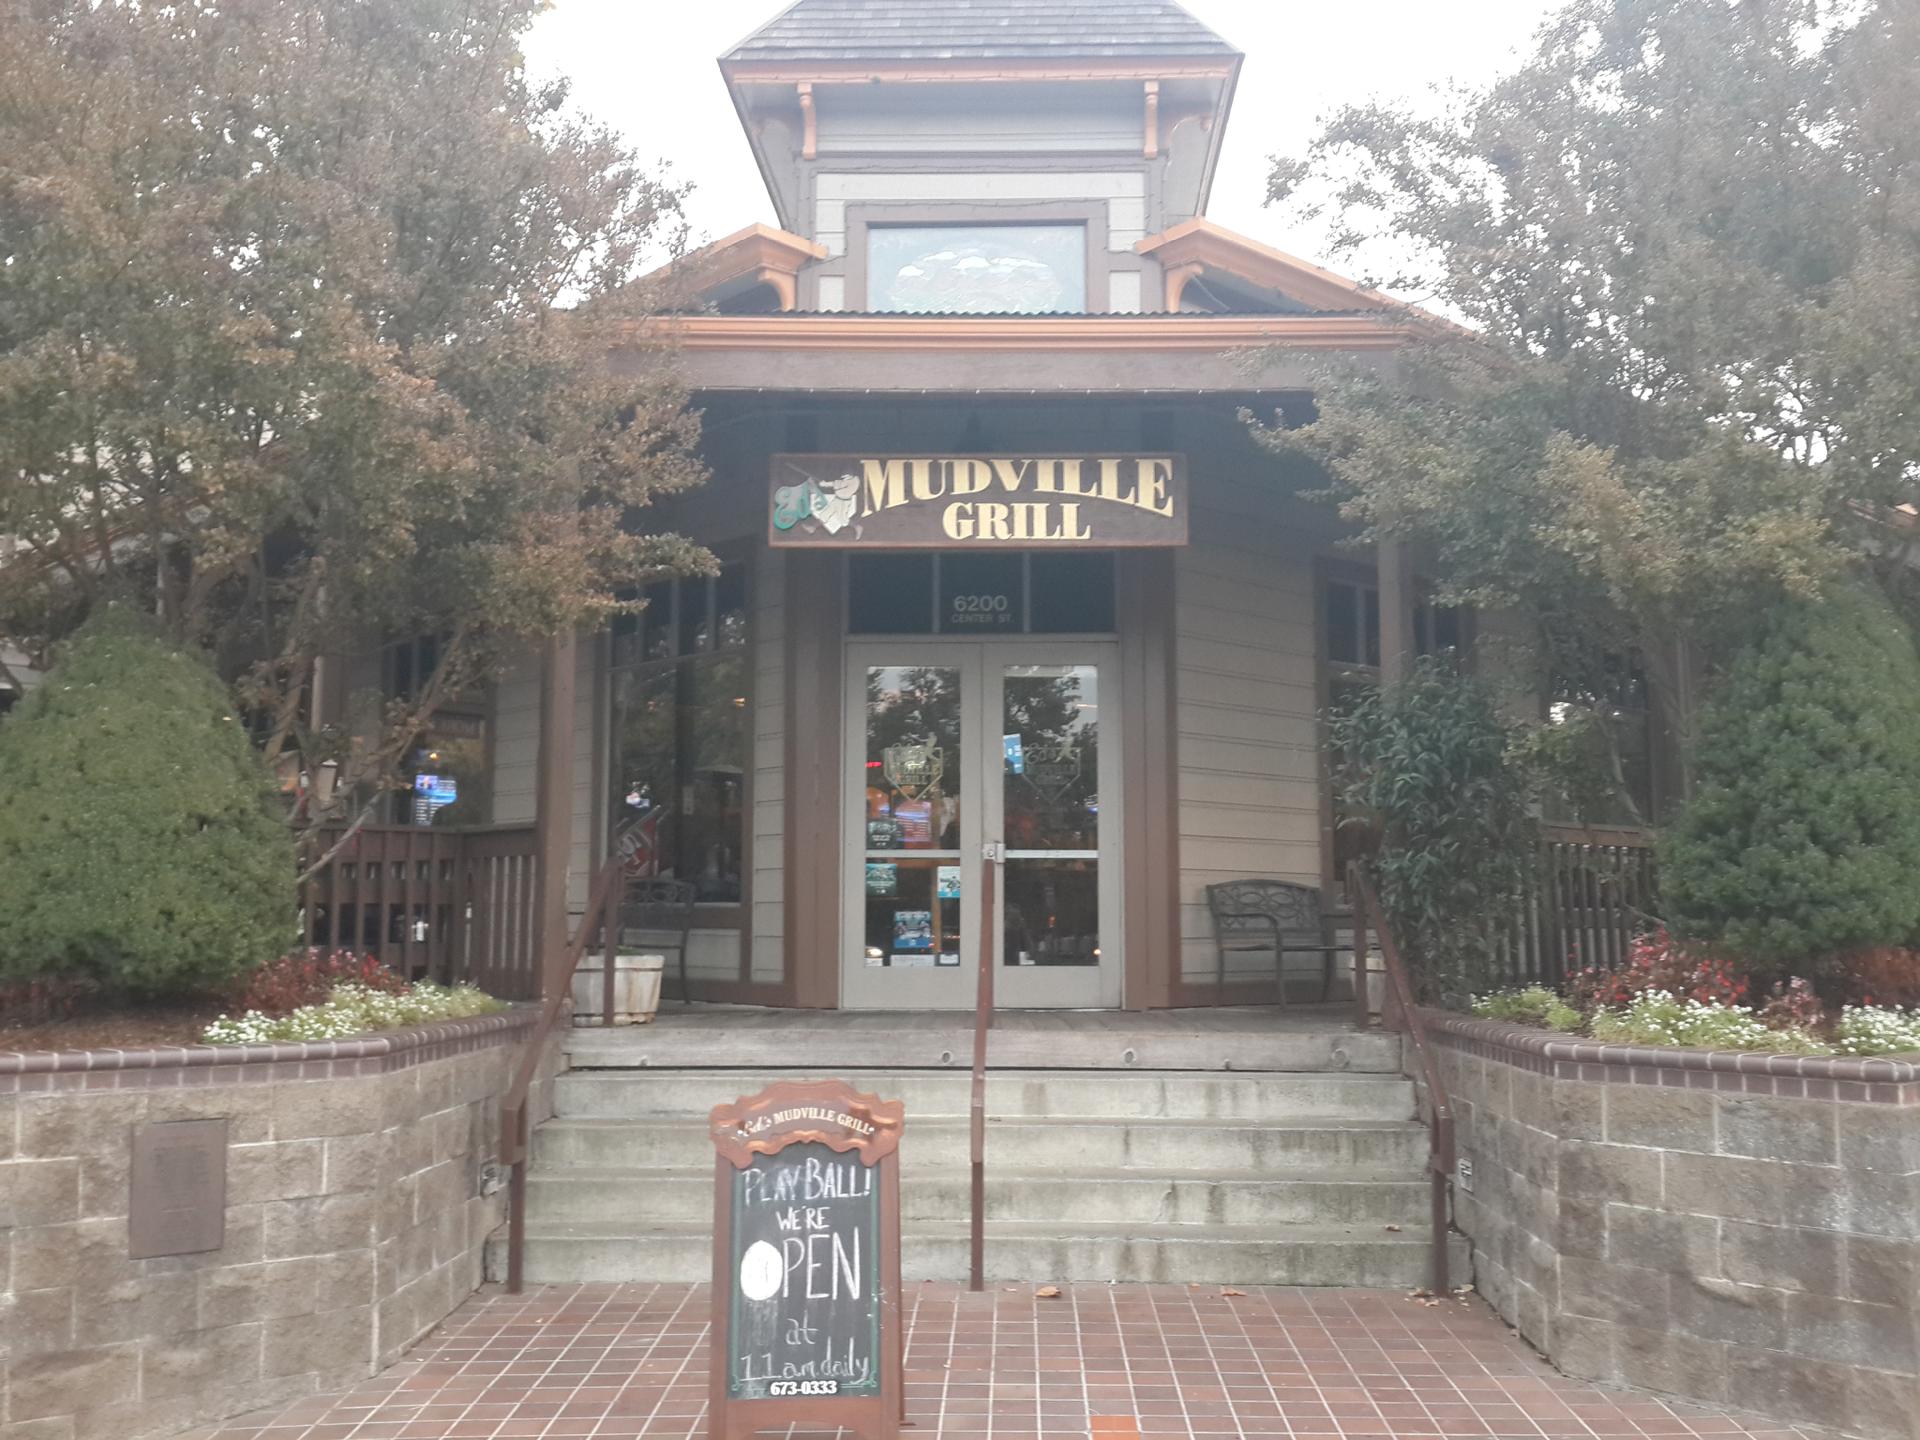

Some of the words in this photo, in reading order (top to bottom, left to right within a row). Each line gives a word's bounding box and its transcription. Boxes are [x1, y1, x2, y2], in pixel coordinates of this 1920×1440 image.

[860, 457, 1174, 519] MUDVILLE
[942, 501, 1092, 541] GRILL
[951, 613, 994, 625] CENTER
[953, 594, 1008, 612] 6200
[773, 1107, 836, 1125] MUDVILLE
[837, 1113, 871, 1135] GRILL
[741, 1165, 801, 1206] PLAY
[804, 1157, 871, 1200] BALL!
[740, 1226, 861, 1301] OPEN
[785, 1310, 819, 1345] at
[820, 1336, 869, 1385] daily
[769, 1380, 838, 1396] 673-0333
